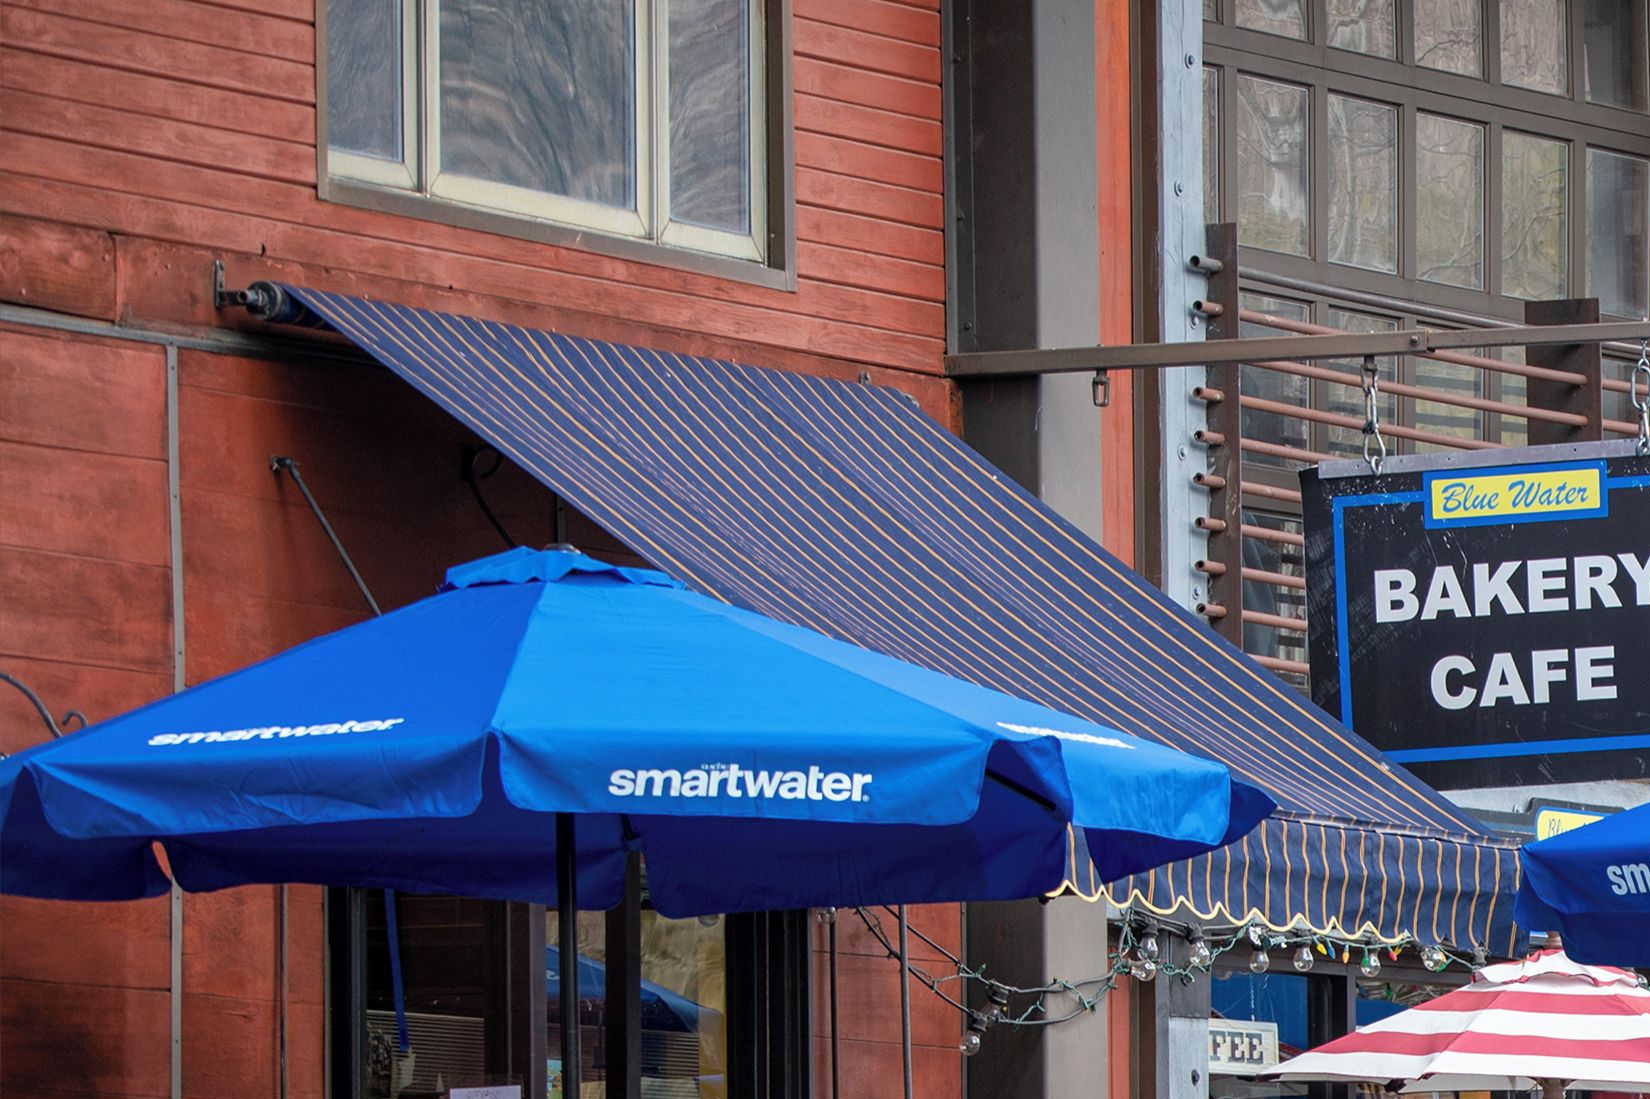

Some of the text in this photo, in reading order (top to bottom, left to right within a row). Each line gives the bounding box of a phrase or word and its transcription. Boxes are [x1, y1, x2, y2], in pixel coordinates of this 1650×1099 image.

[1440, 480, 1590, 513] Blue Water
[1430, 645, 1618, 710] CAFE
[608, 763, 872, 802] smartwater
